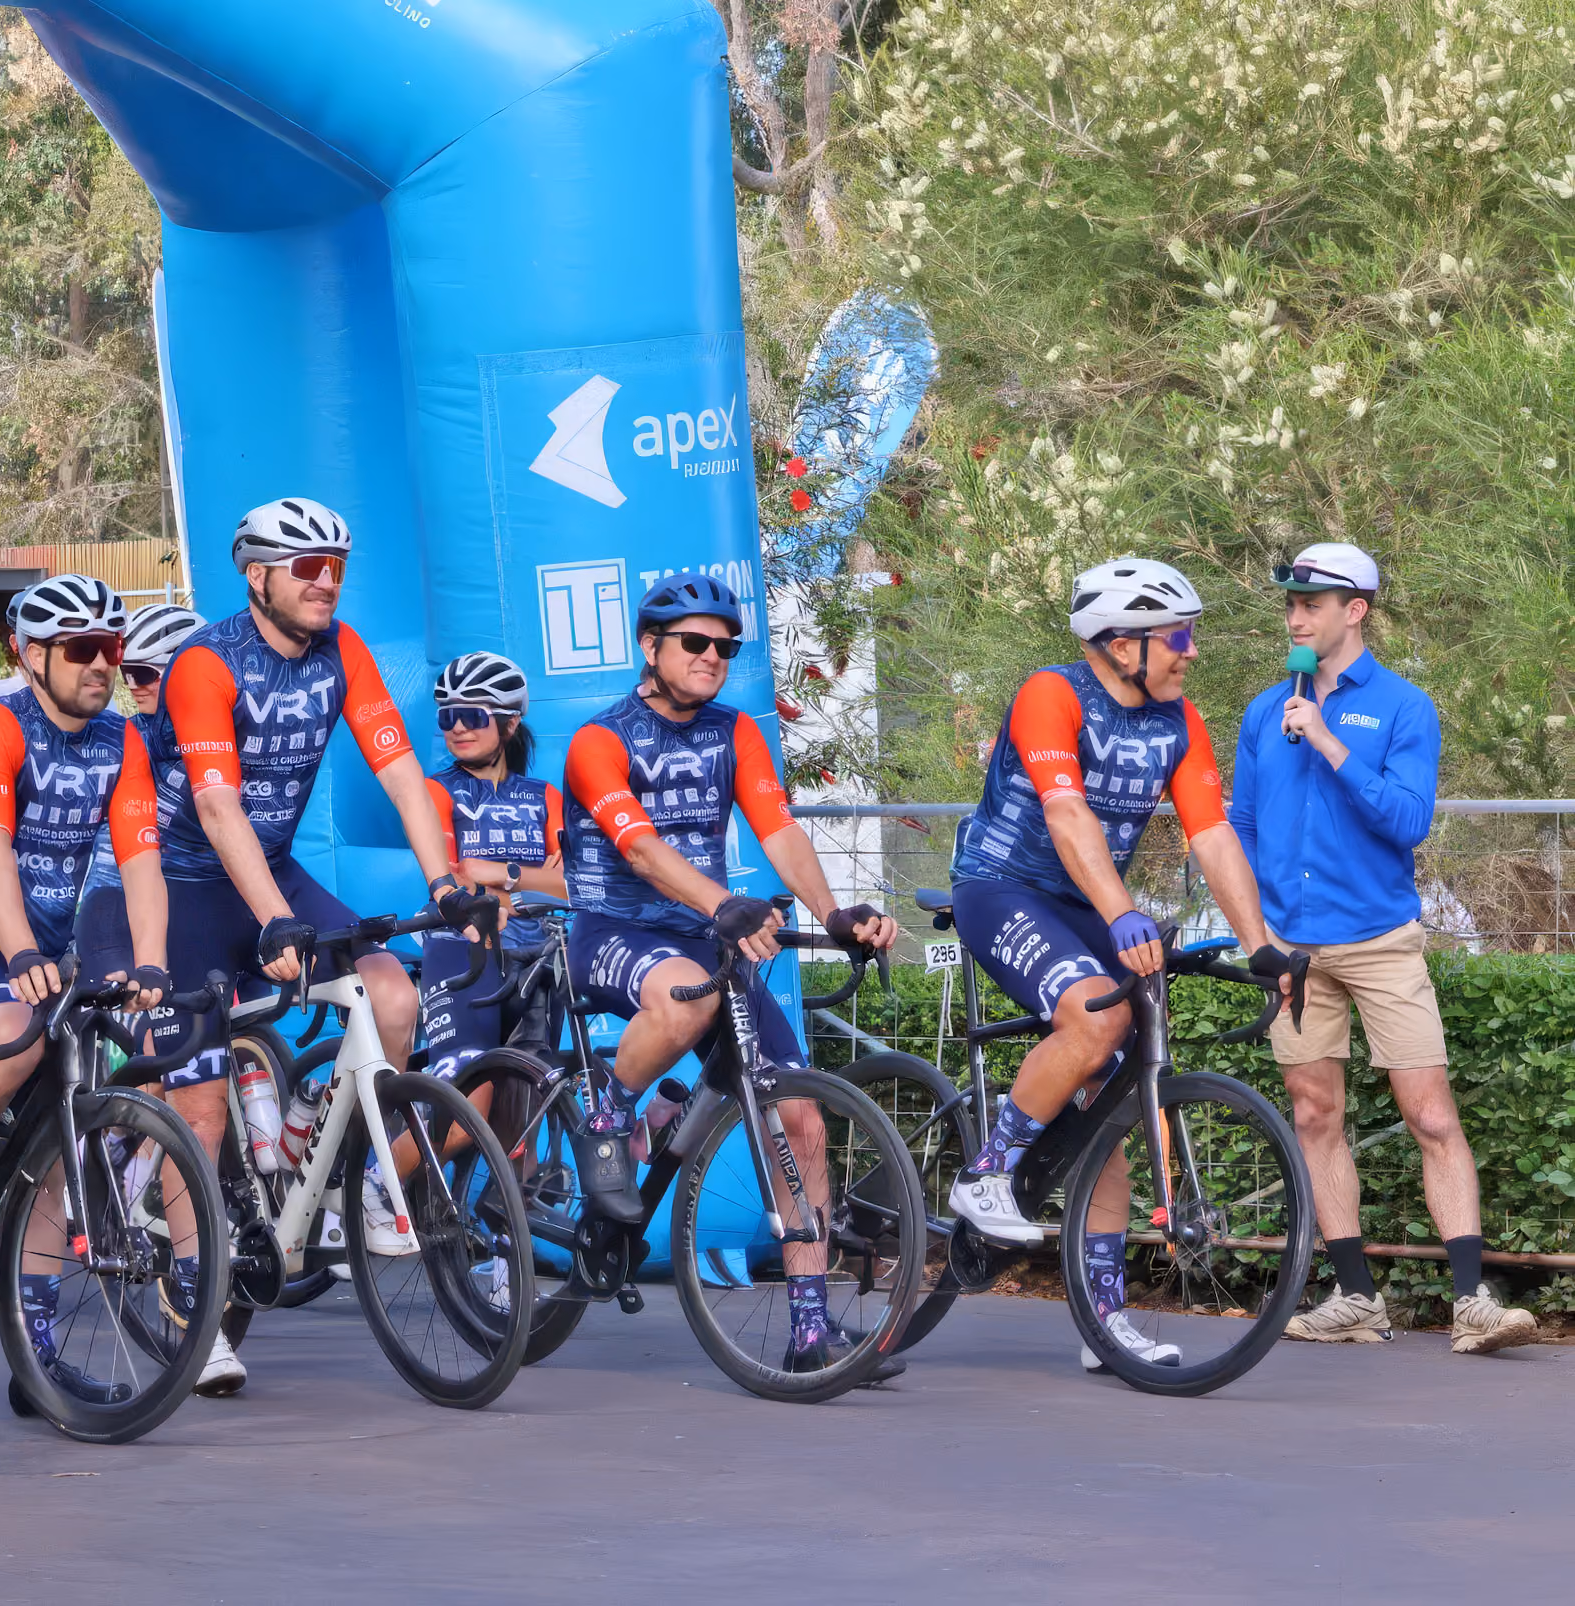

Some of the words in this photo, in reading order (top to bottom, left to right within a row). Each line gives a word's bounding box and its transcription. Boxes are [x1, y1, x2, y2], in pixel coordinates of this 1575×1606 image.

[632, 392, 738, 470] apex
[245, 675, 336, 724] VRT
[634, 744, 726, 783] VRT
[1086, 724, 1178, 769] VRT
[29, 752, 121, 798] VRT
[456, 803, 542, 824] VRT
